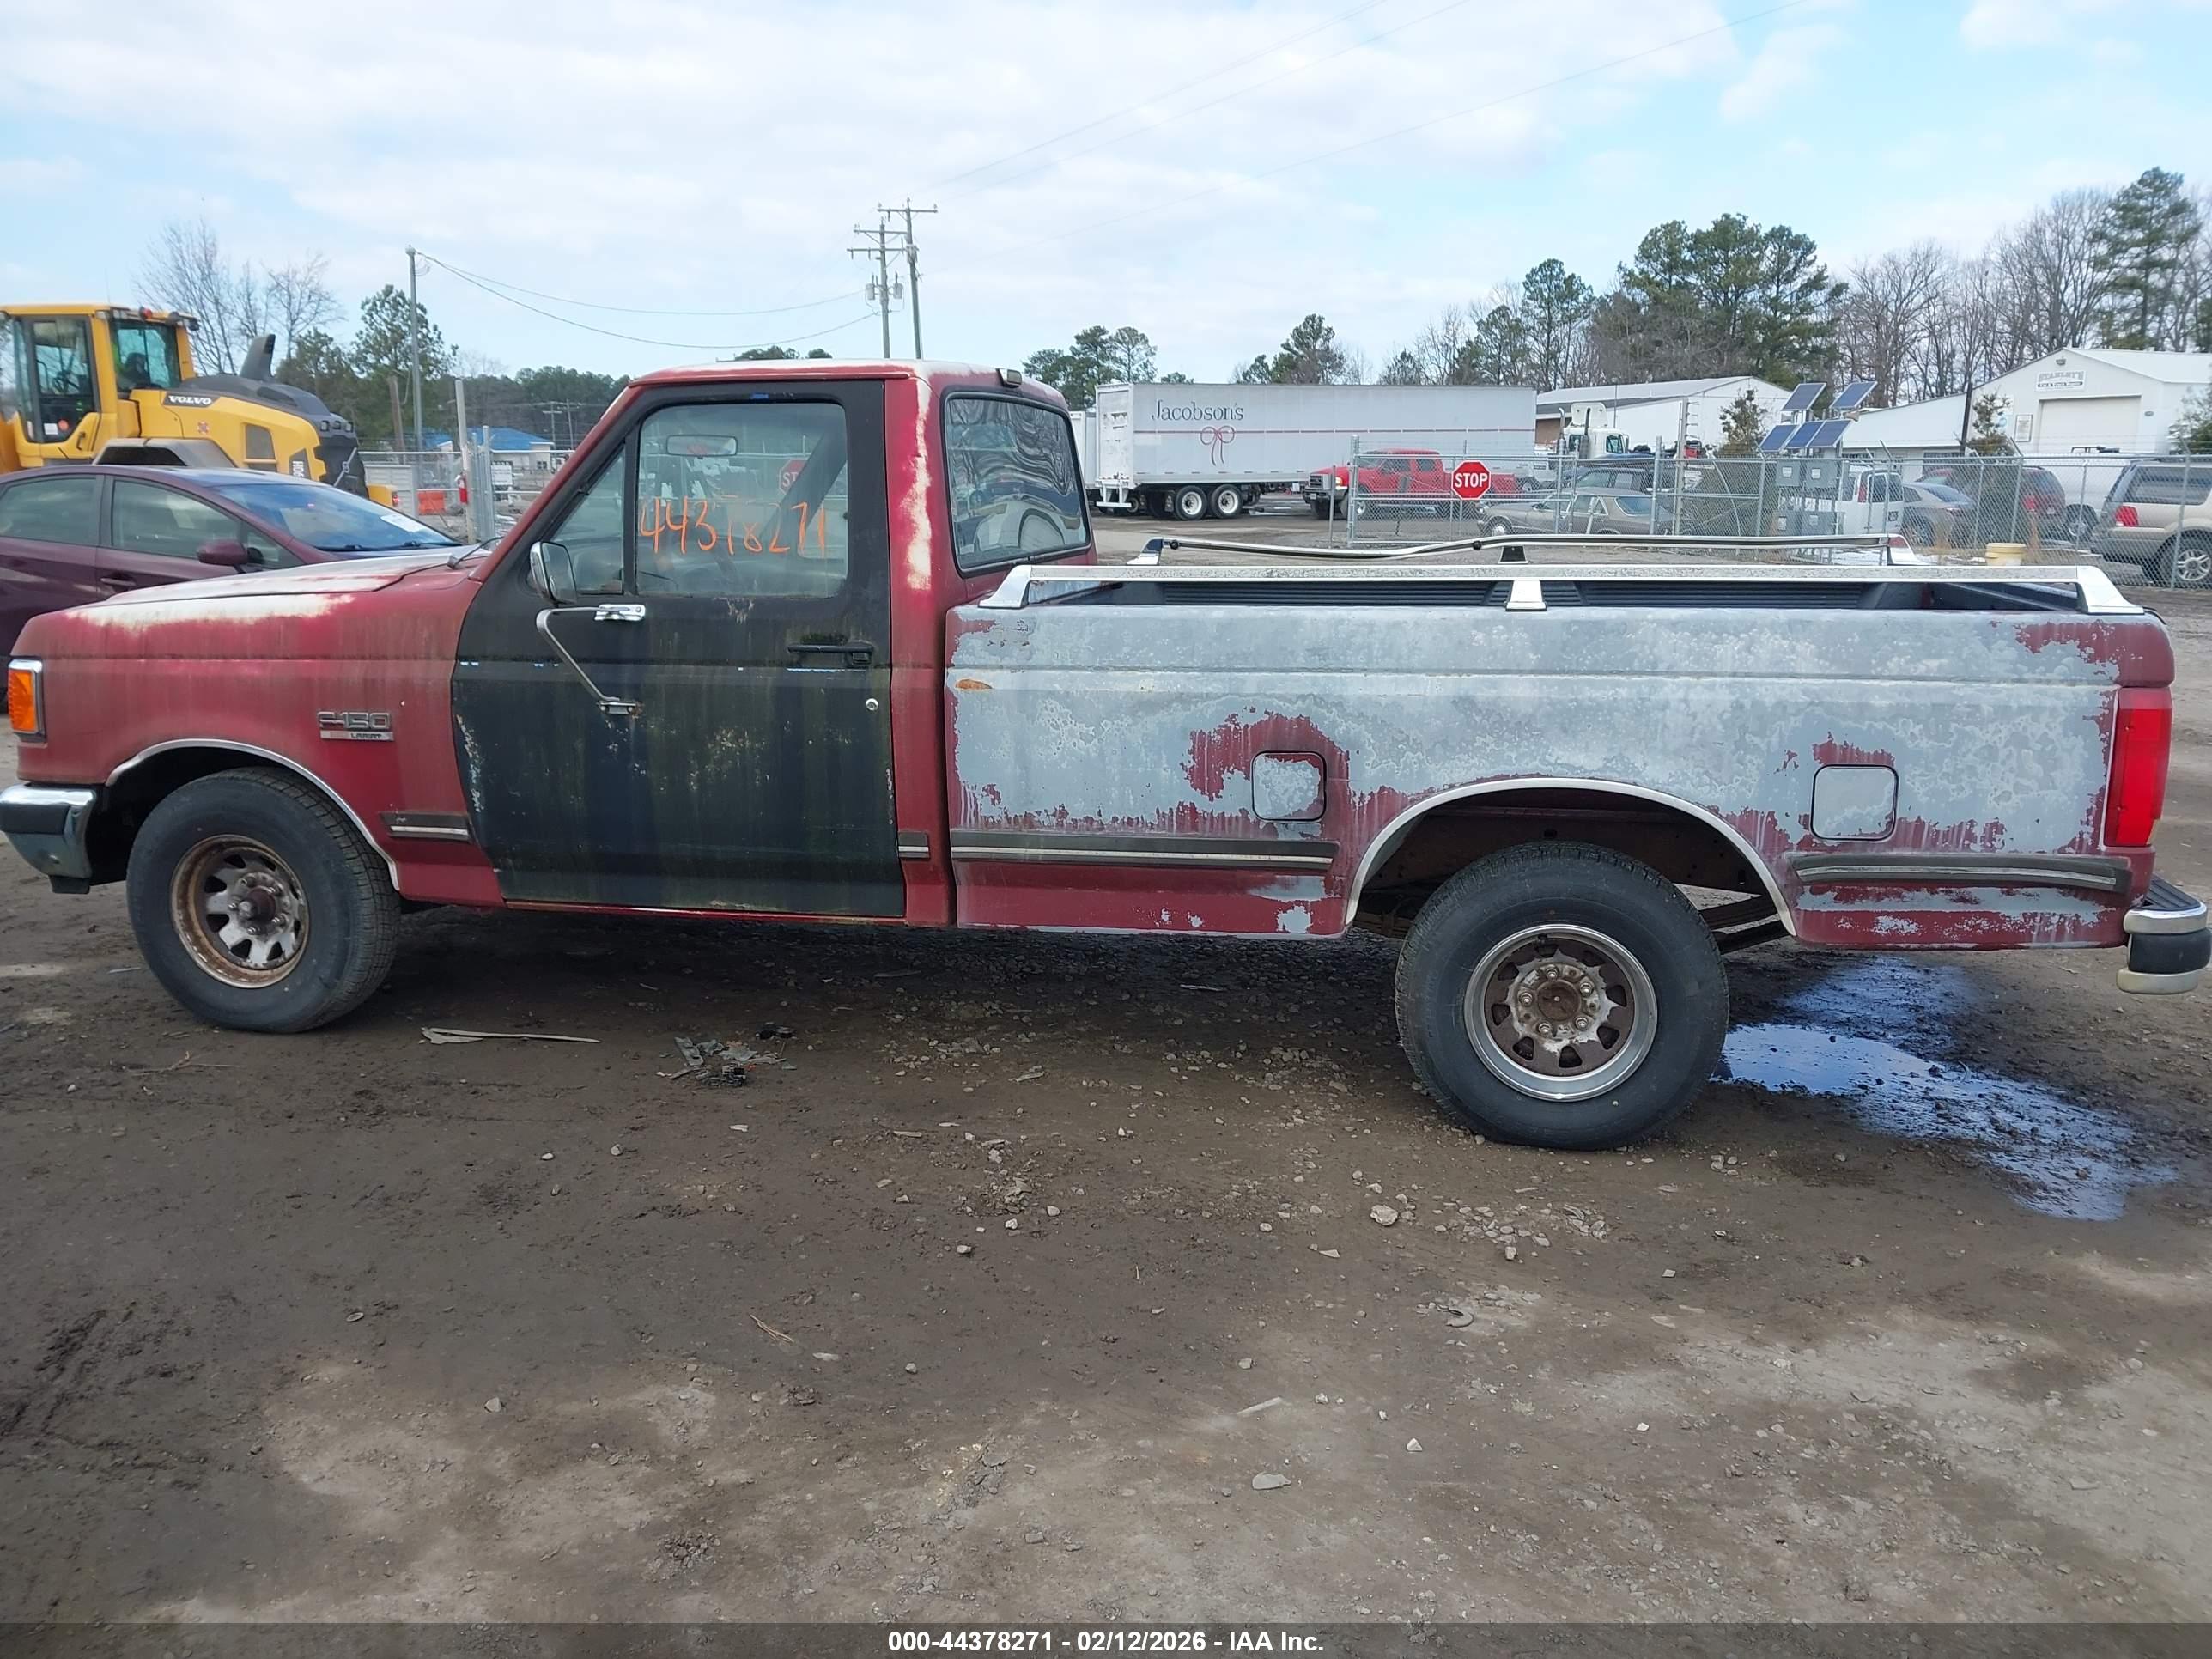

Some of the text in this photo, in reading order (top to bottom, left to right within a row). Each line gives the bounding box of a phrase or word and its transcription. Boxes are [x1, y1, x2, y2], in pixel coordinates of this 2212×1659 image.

[168, 395, 212, 405] VOLVO
[1151, 399, 1244, 421] Jacobson's
[782, 471, 799, 487] ST
[1454, 472, 1488, 488] STOP
[317, 711, 390, 728] F-150
